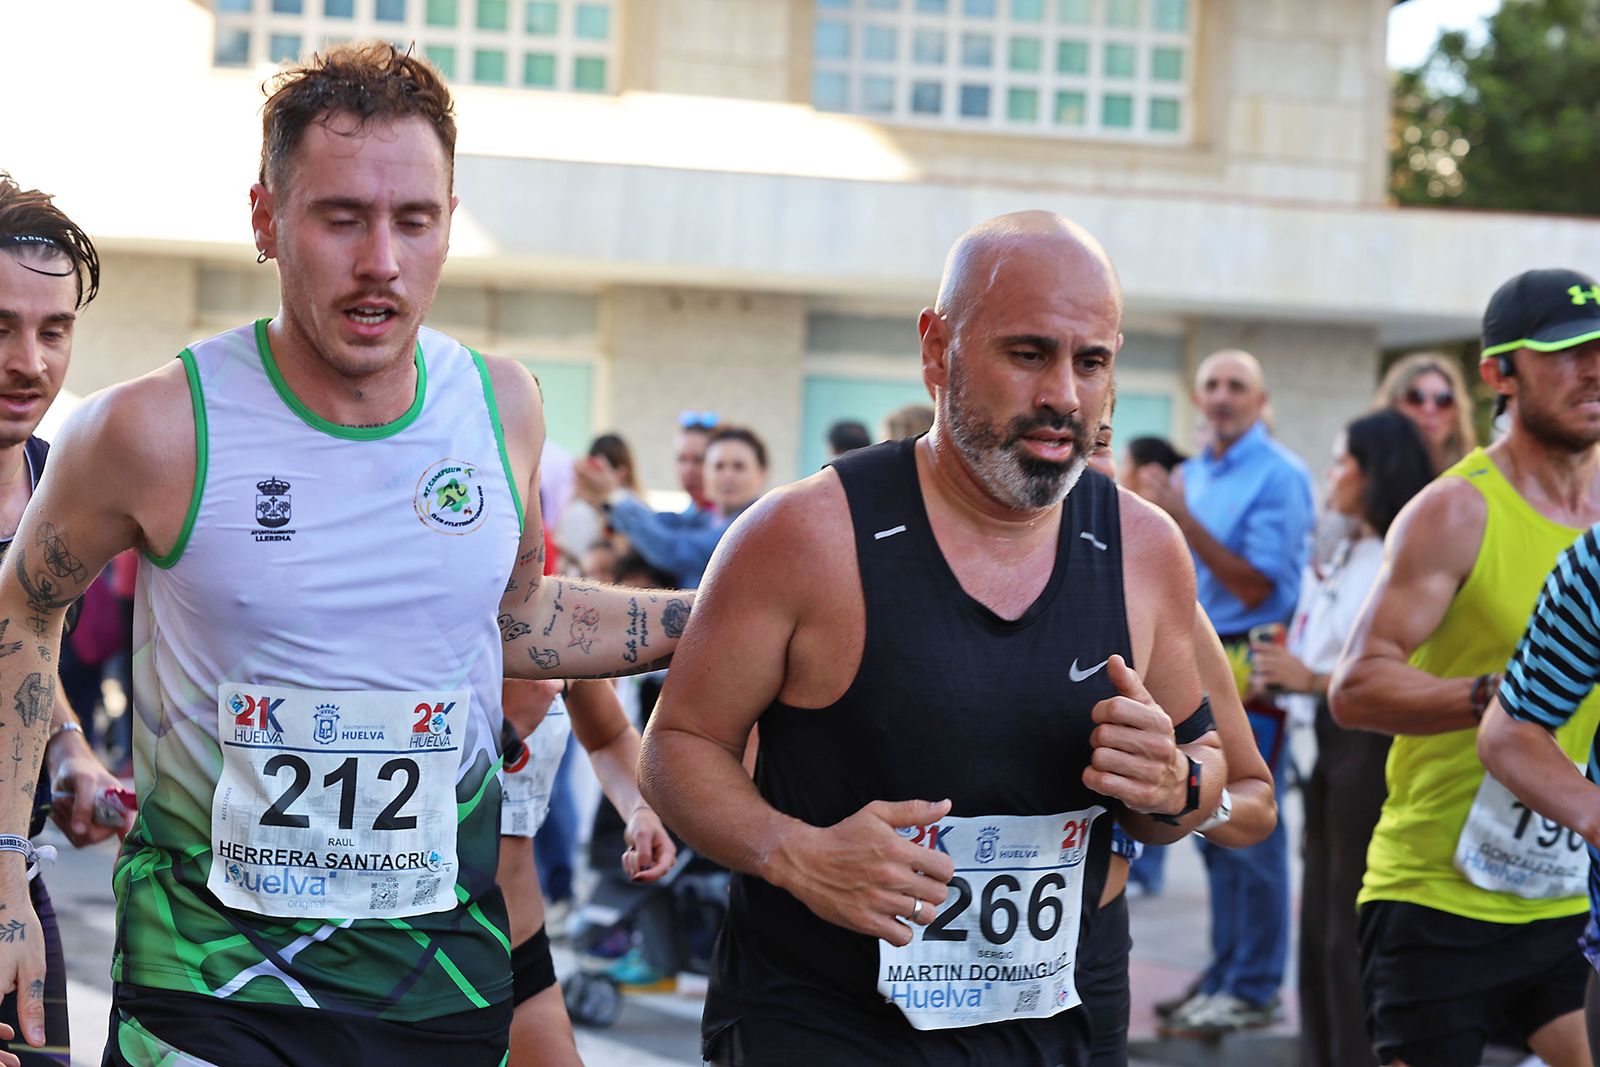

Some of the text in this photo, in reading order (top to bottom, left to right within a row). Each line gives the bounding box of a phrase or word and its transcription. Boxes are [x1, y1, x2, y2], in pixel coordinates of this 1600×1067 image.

[235, 695, 286, 733] 21K
[234, 729, 284, 745] HUELVA
[341, 731, 385, 740] HUELVA
[409, 736, 451, 748] HUELVA
[259, 754, 420, 830] 212
[328, 838, 354, 847] RAUL
[218, 840, 318, 867] HERRERA
[999, 849, 1039, 859] HUELVA
[288, 899, 326, 910] original
[922, 873, 1066, 945] 266
[977, 950, 1015, 960] SERGIO
[888, 965, 962, 982] MARTIN
[891, 982, 982, 1009] Huelva
